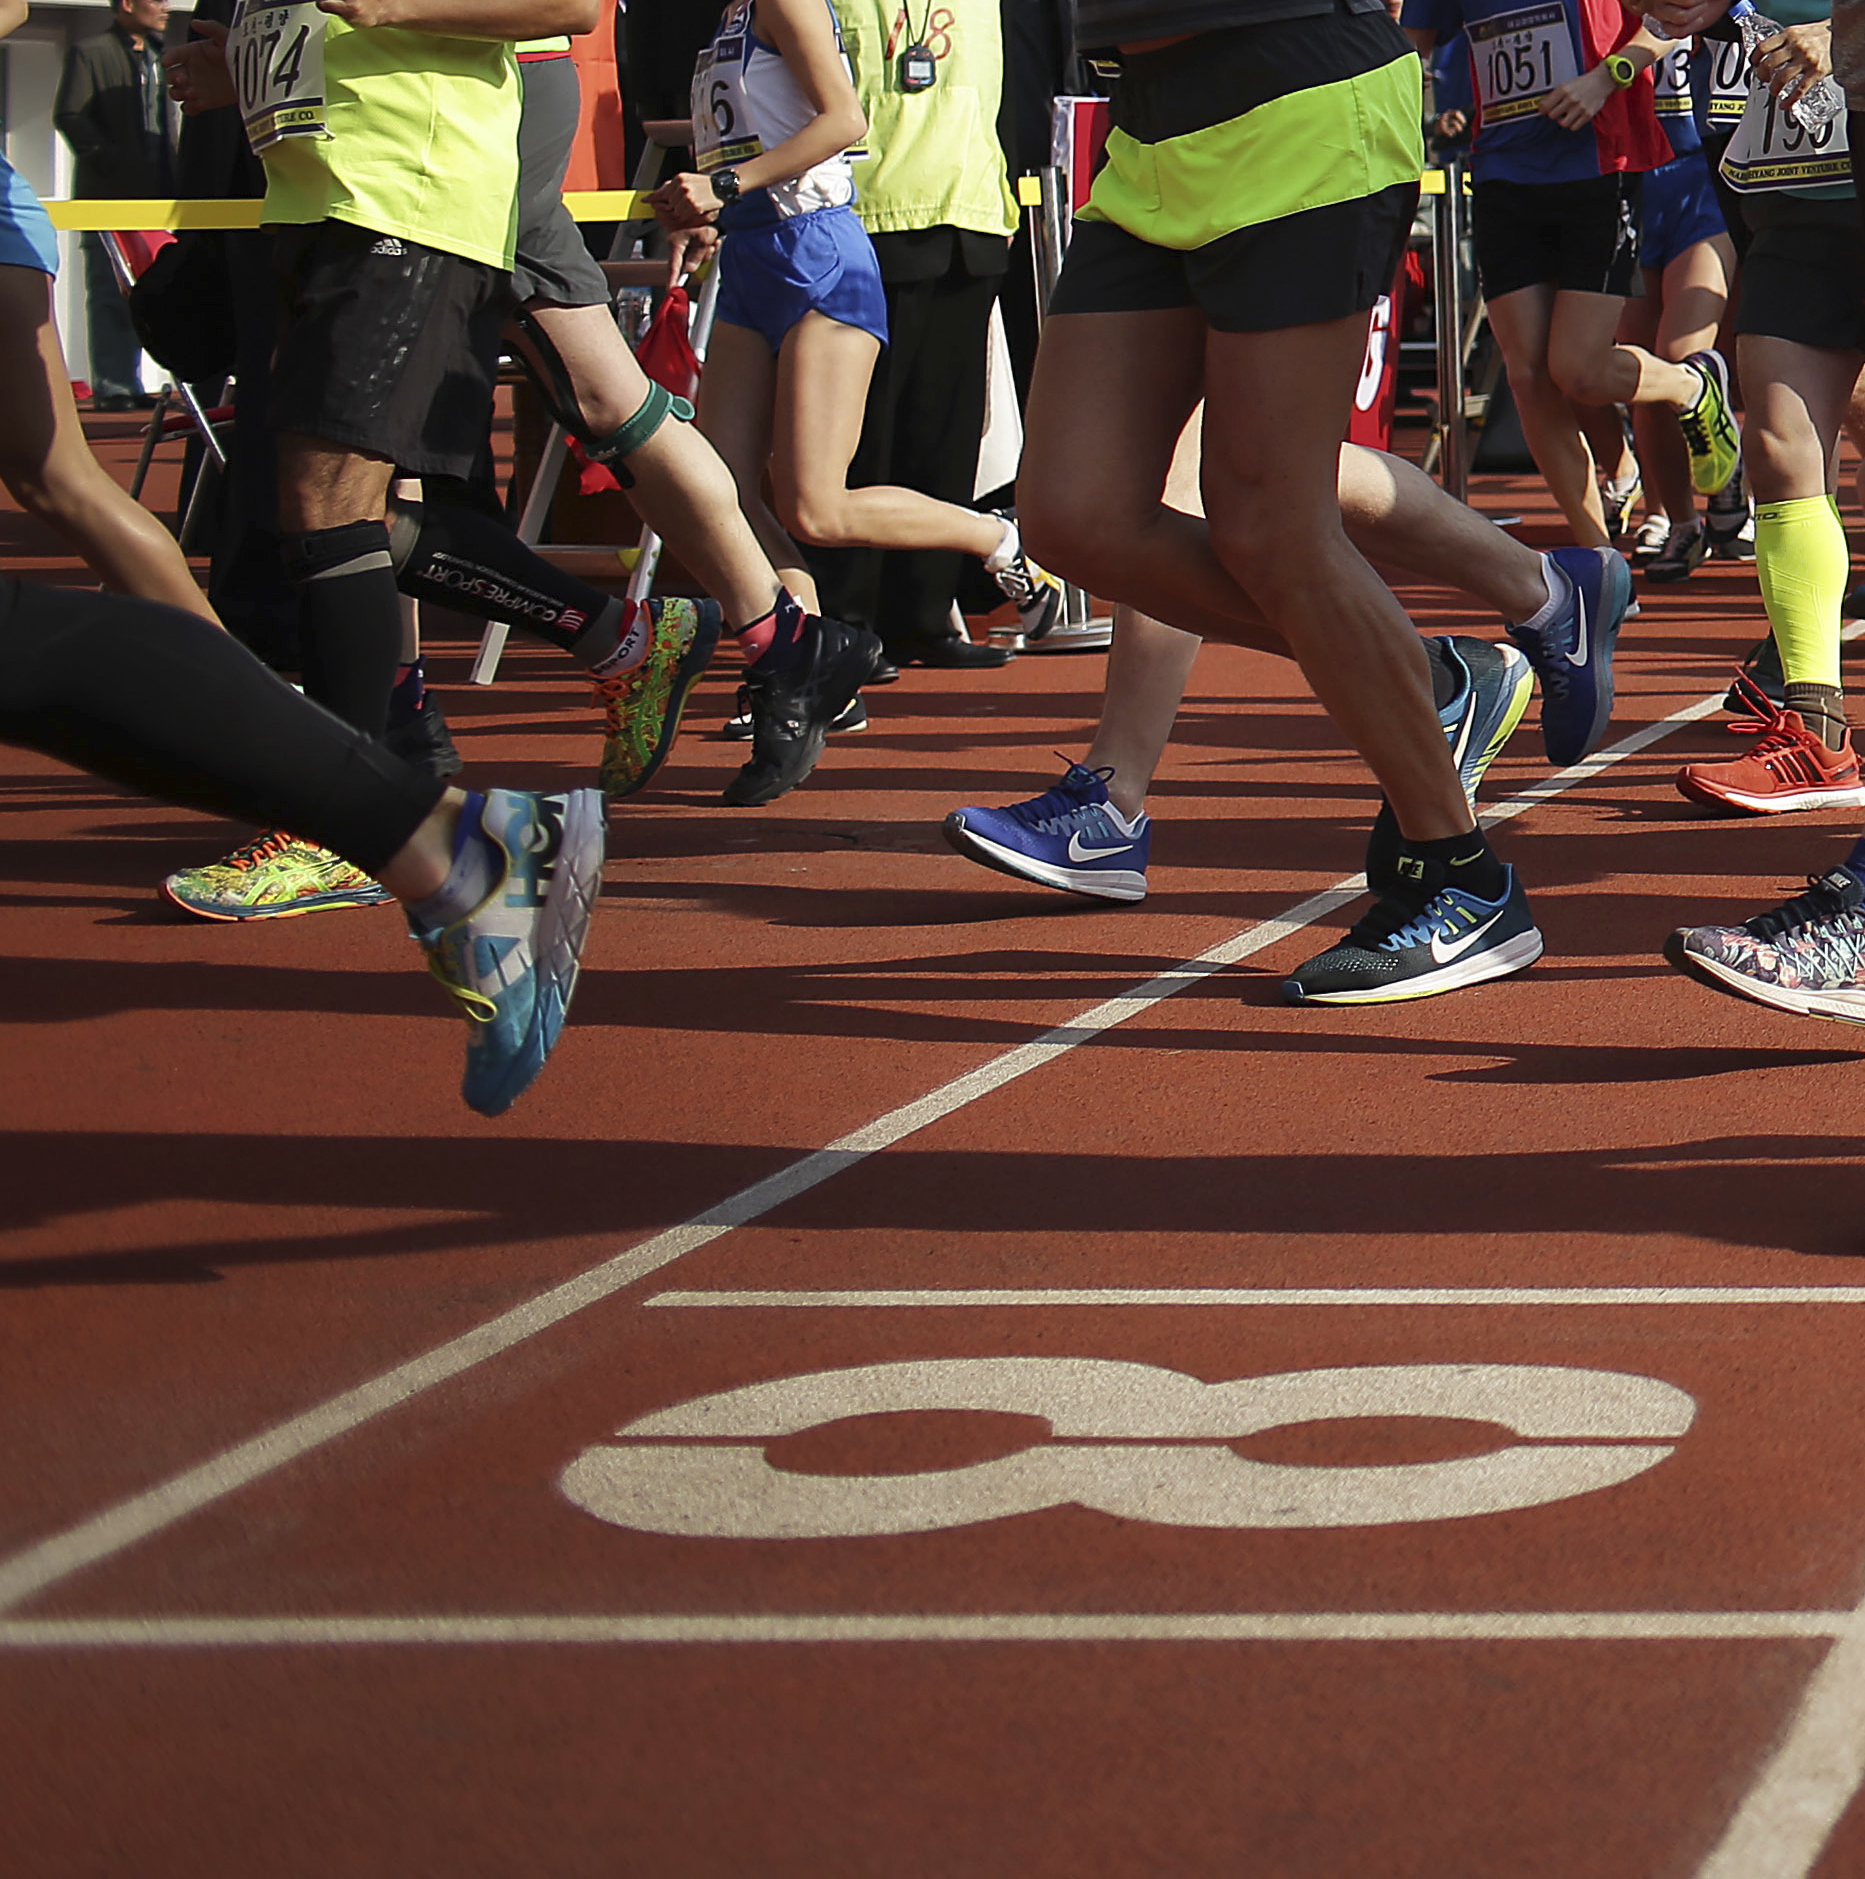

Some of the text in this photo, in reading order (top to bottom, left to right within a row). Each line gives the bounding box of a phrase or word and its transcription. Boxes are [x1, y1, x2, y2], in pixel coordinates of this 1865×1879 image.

[233, 24, 310, 109] 1074
[1488, 39, 1553, 100] 1051
[560, 1355, 1698, 1538] 8
